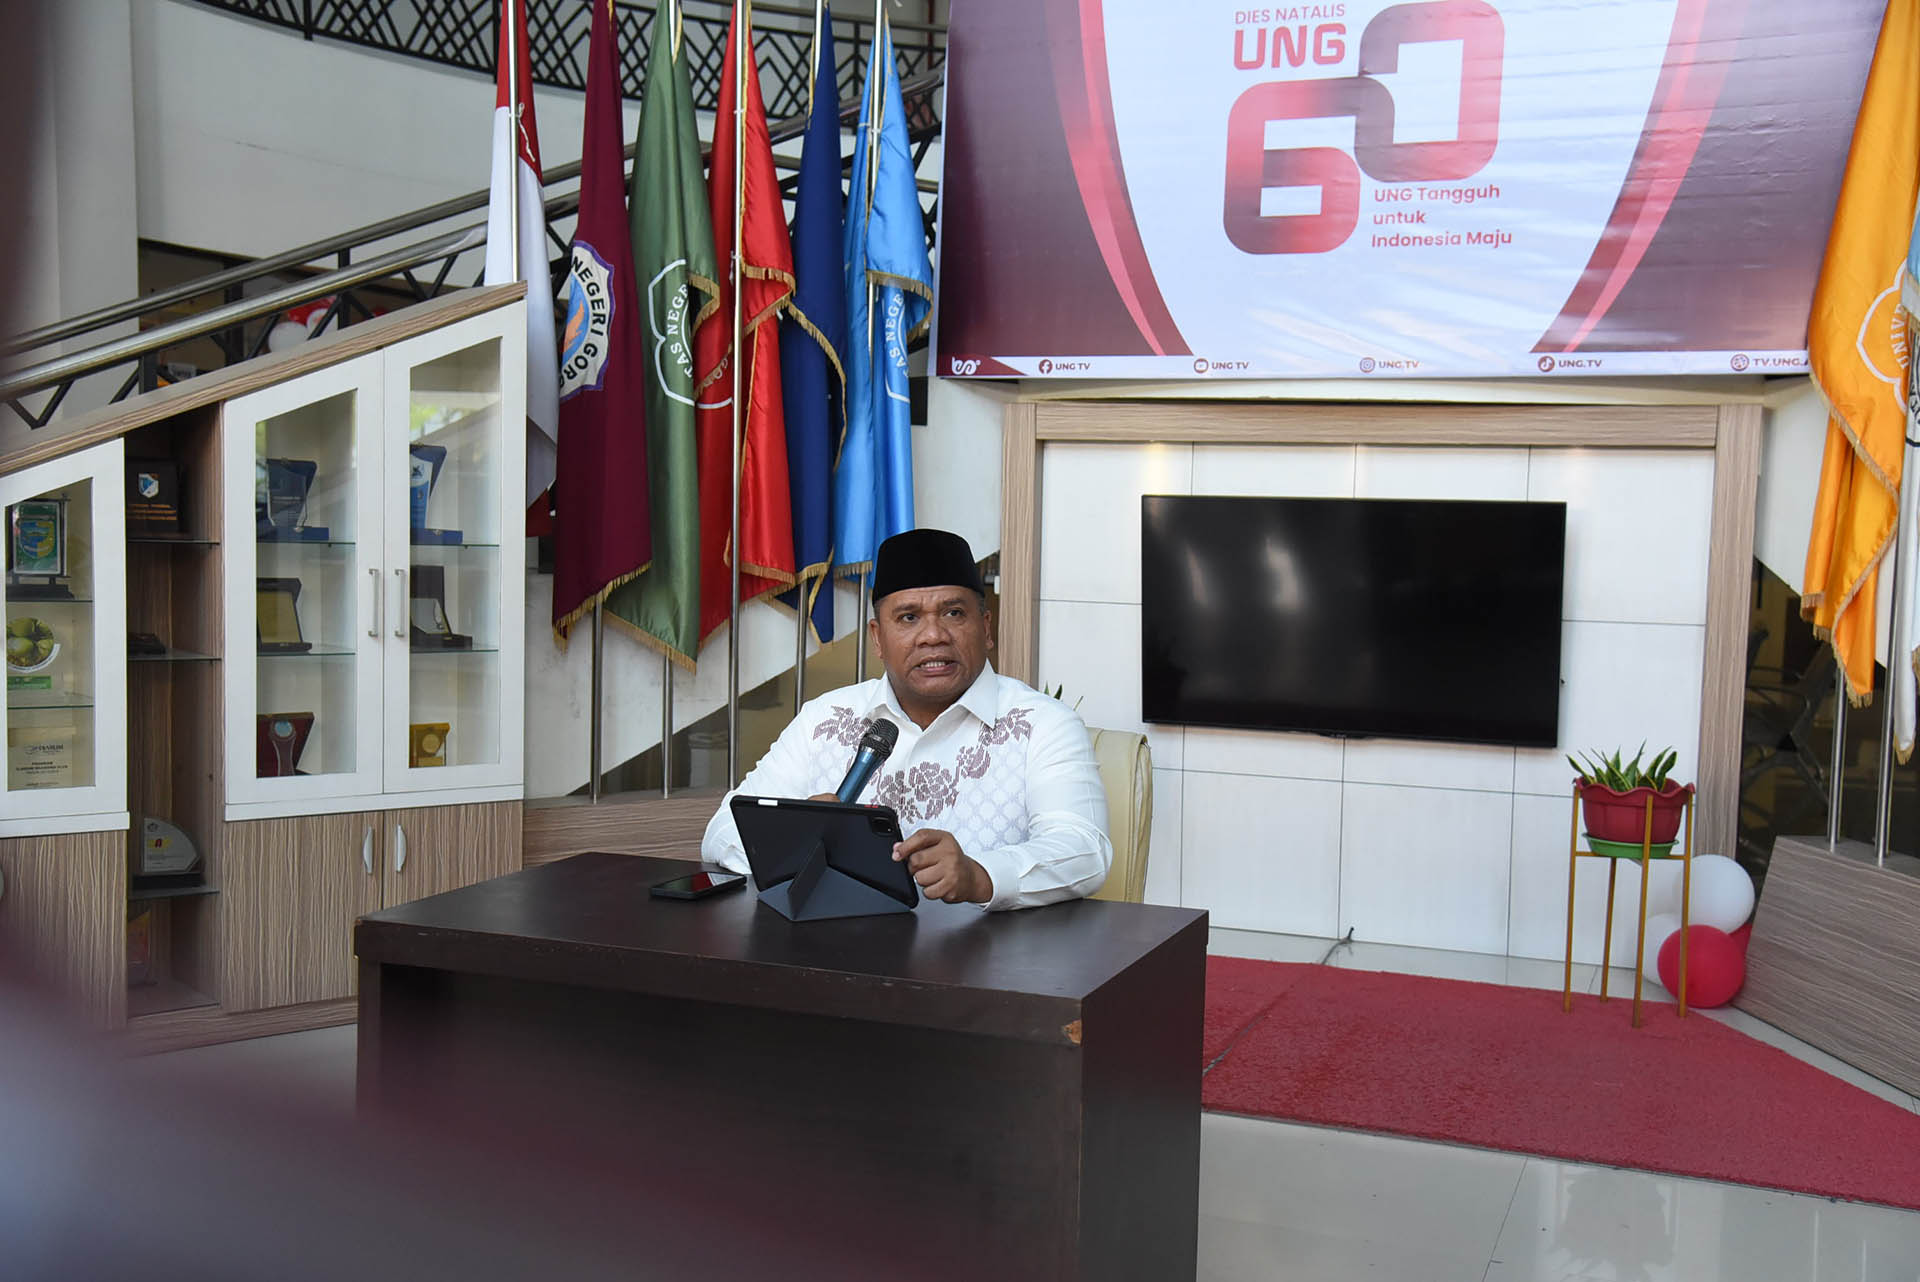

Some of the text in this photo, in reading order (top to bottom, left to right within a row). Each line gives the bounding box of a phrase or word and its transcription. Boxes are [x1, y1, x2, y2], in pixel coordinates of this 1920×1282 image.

[1235, 4, 1345, 25] DIES NATALIS
[1233, 23, 1346, 70] UNG
[1374, 184, 1500, 203] UNG Tangguh
[1373, 211, 1426, 225] untuk
[1371, 231, 1512, 249] Indonesia Maju
[571, 256, 606, 337] NEGERI
[1055, 362, 1091, 371] UNG TV
[1211, 362, 1250, 370] UNG TV
